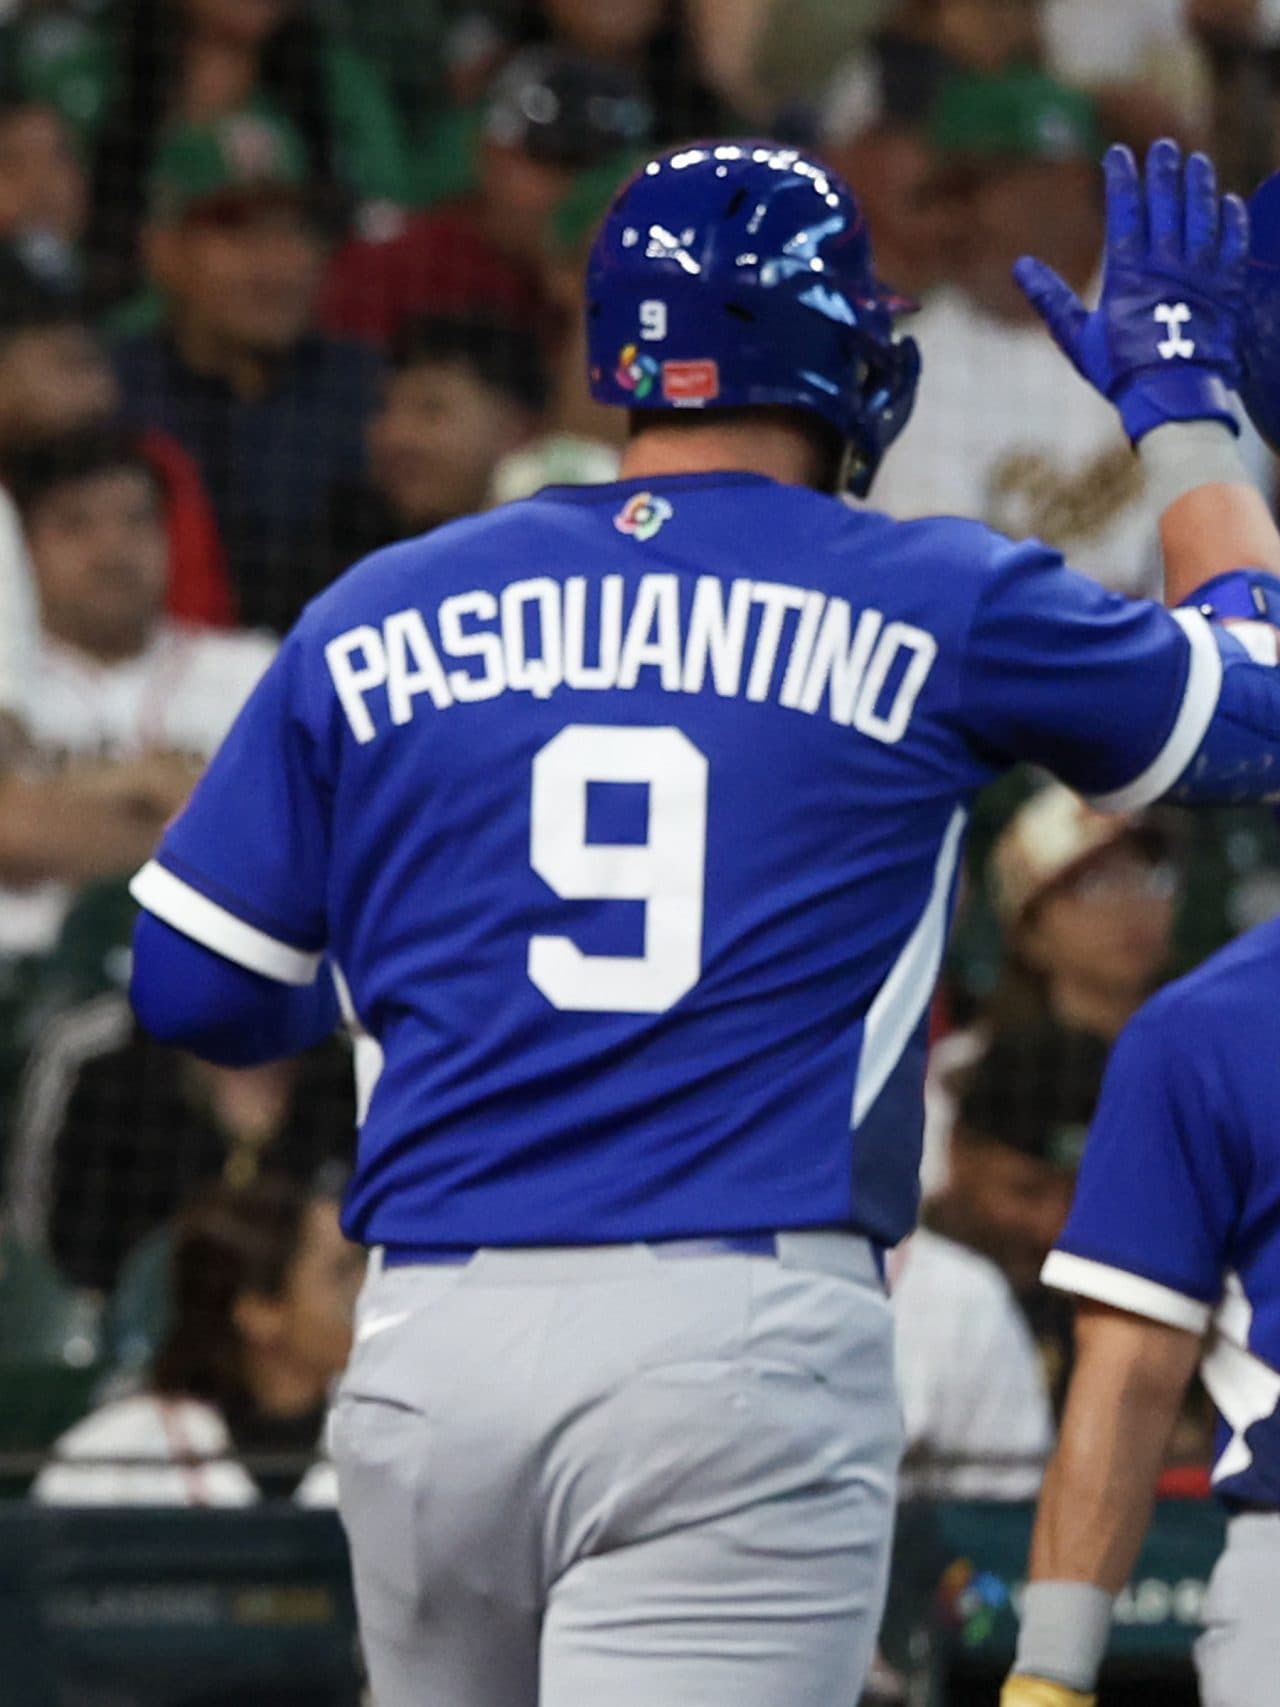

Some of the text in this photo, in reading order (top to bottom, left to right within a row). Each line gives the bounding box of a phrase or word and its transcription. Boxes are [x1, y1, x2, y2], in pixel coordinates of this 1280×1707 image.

[639, 300, 667, 340] 9
[325, 573, 937, 743] PASQUANTINO
[527, 724, 709, 1014] 9
